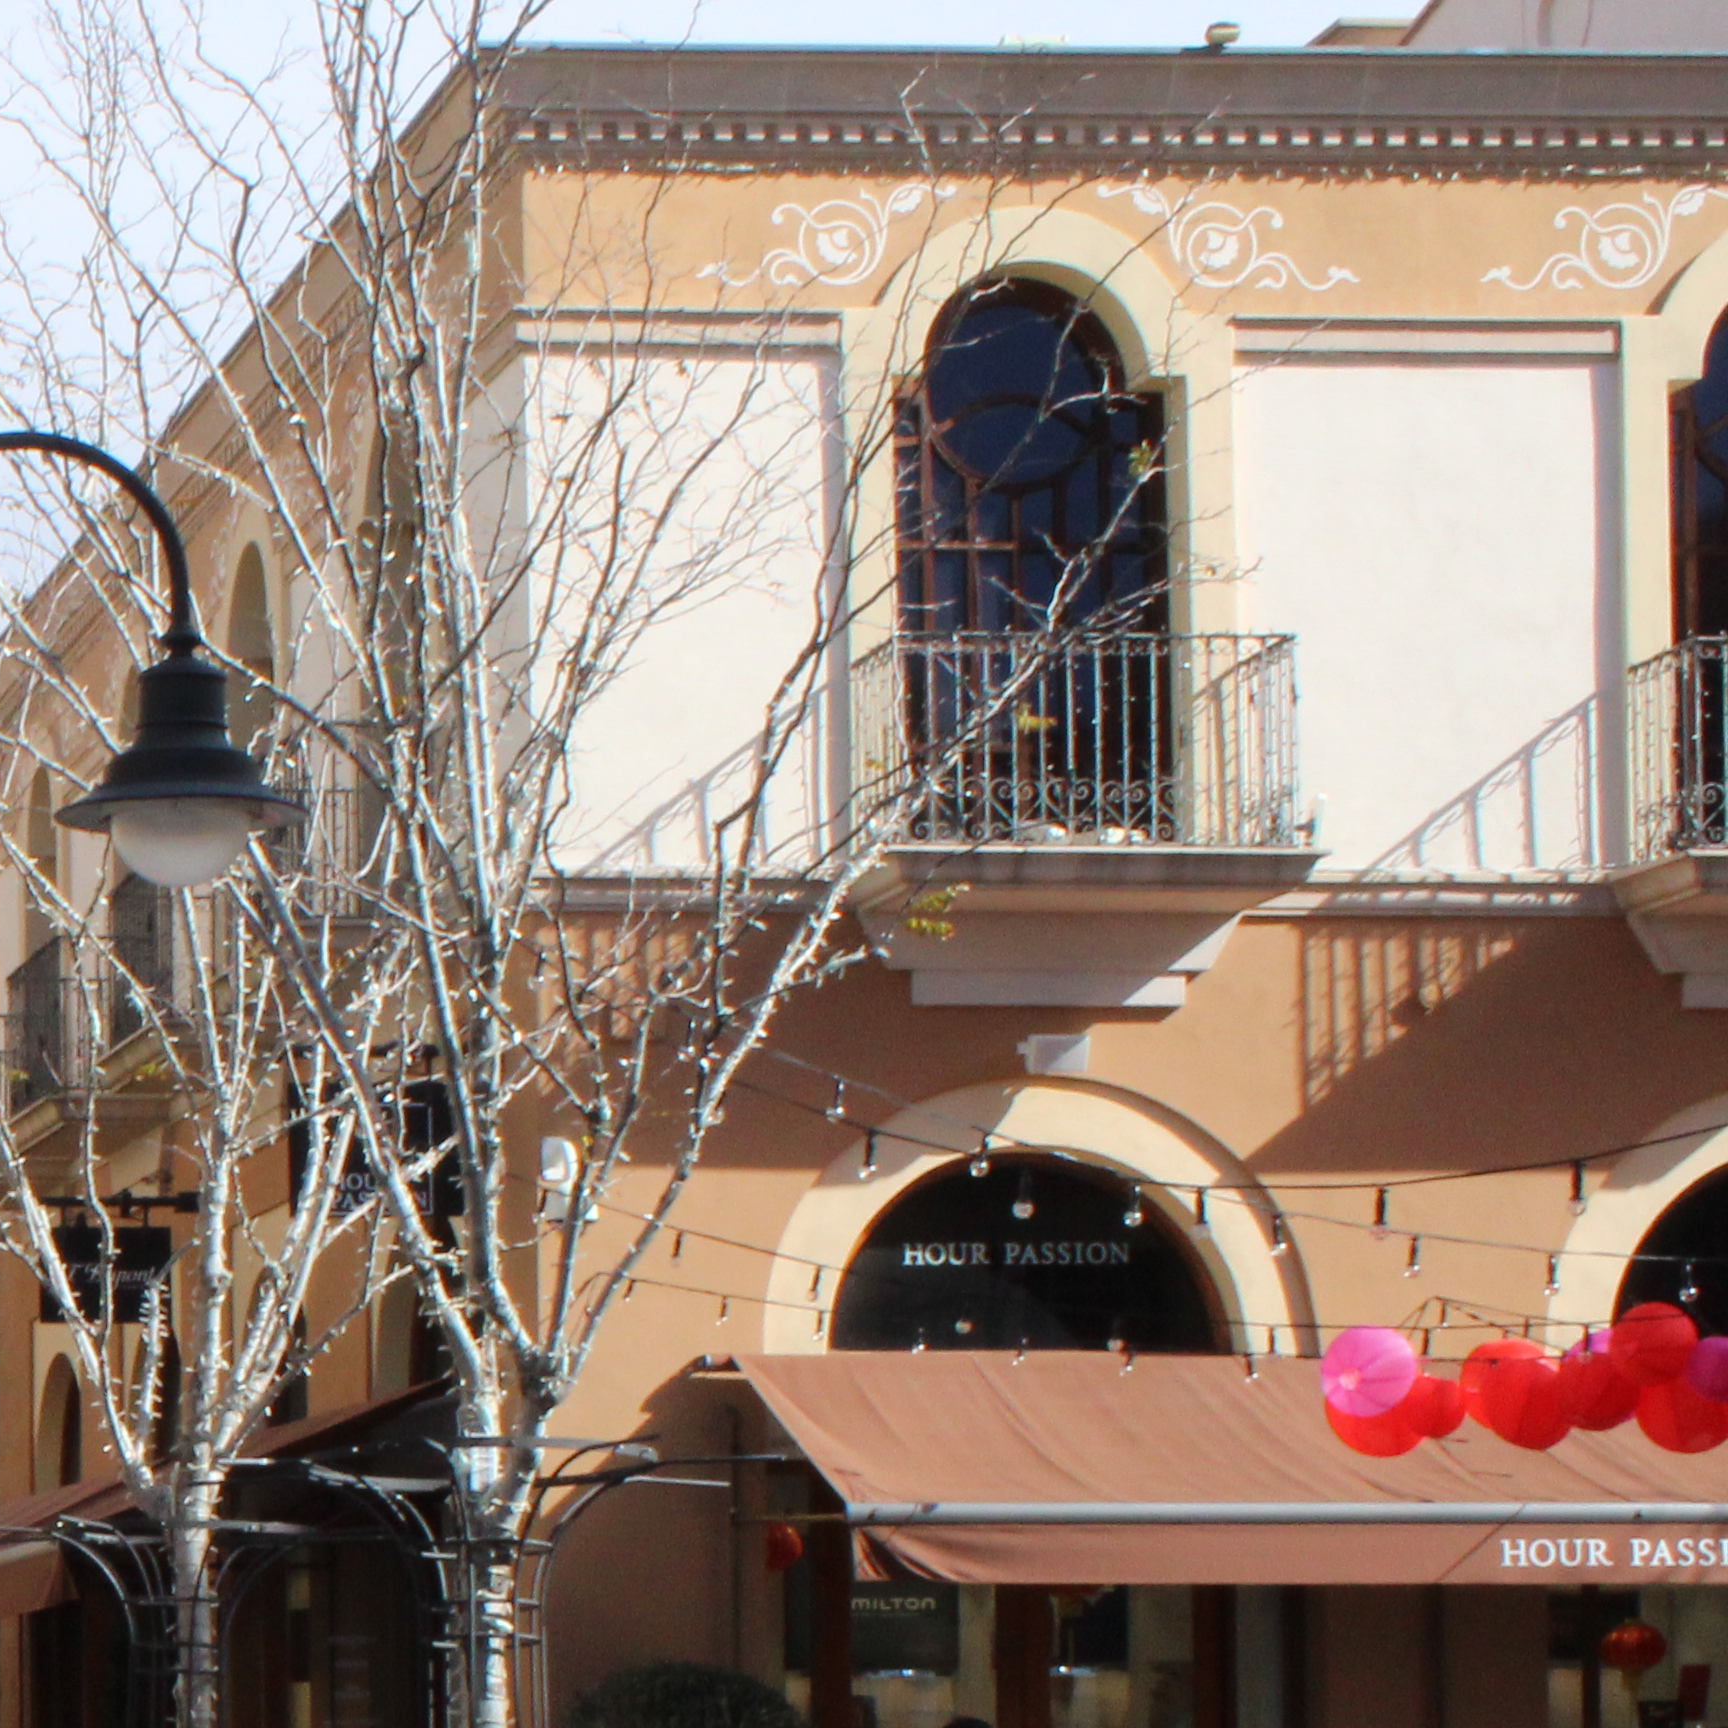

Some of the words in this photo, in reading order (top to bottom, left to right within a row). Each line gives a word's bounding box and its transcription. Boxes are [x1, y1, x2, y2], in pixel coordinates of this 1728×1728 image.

[902, 1242, 990, 1266] HOUR
[1004, 1242, 1130, 1266] PASSION
[1500, 1537, 1614, 1568] HOUR
